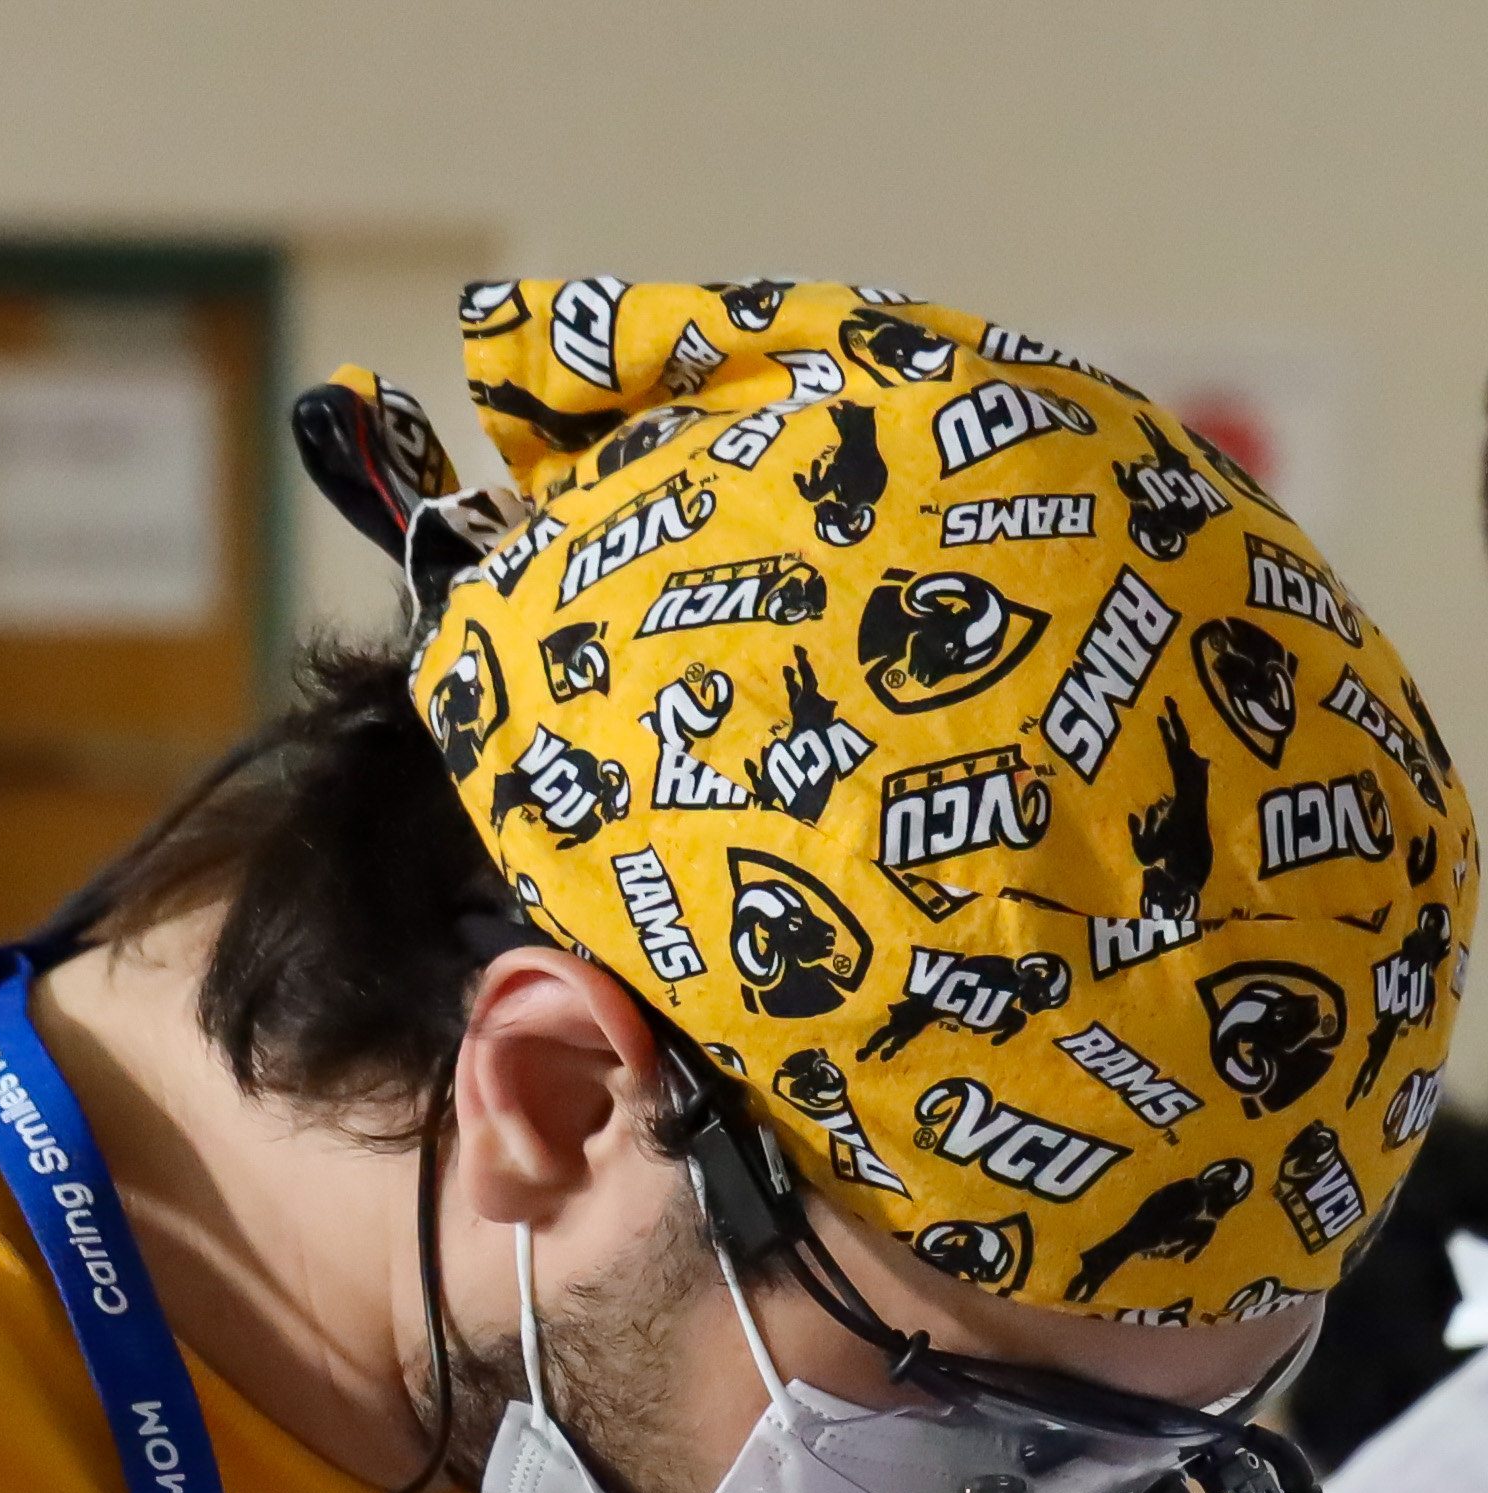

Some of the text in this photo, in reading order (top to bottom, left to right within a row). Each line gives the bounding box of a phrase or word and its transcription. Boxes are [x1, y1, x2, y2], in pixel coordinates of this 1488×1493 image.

[939, 383, 1090, 470] VCU
[944, 496, 1091, 545] RAMS
[1136, 468, 1229, 514] VCU
[562, 490, 713, 604] VCU
[639, 577, 762, 635] VCU
[1253, 556, 1361, 641] VCU
[1045, 572, 1174, 777] RAMS
[517, 724, 598, 829] VCU
[767, 721, 872, 807] VCU
[884, 773, 1030, 866] VCU
[1264, 782, 1382, 868] VCU
[614, 848, 703, 981] RAMS
[908, 950, 1015, 1028] VCU
[1376, 956, 1428, 1019] VCU
[1059, 1026, 1199, 1125] RAMS
[942, 1082, 1120, 1197] VCU
[1305, 1161, 1362, 1240] VCU
[52, 1182, 128, 1315] Caring
